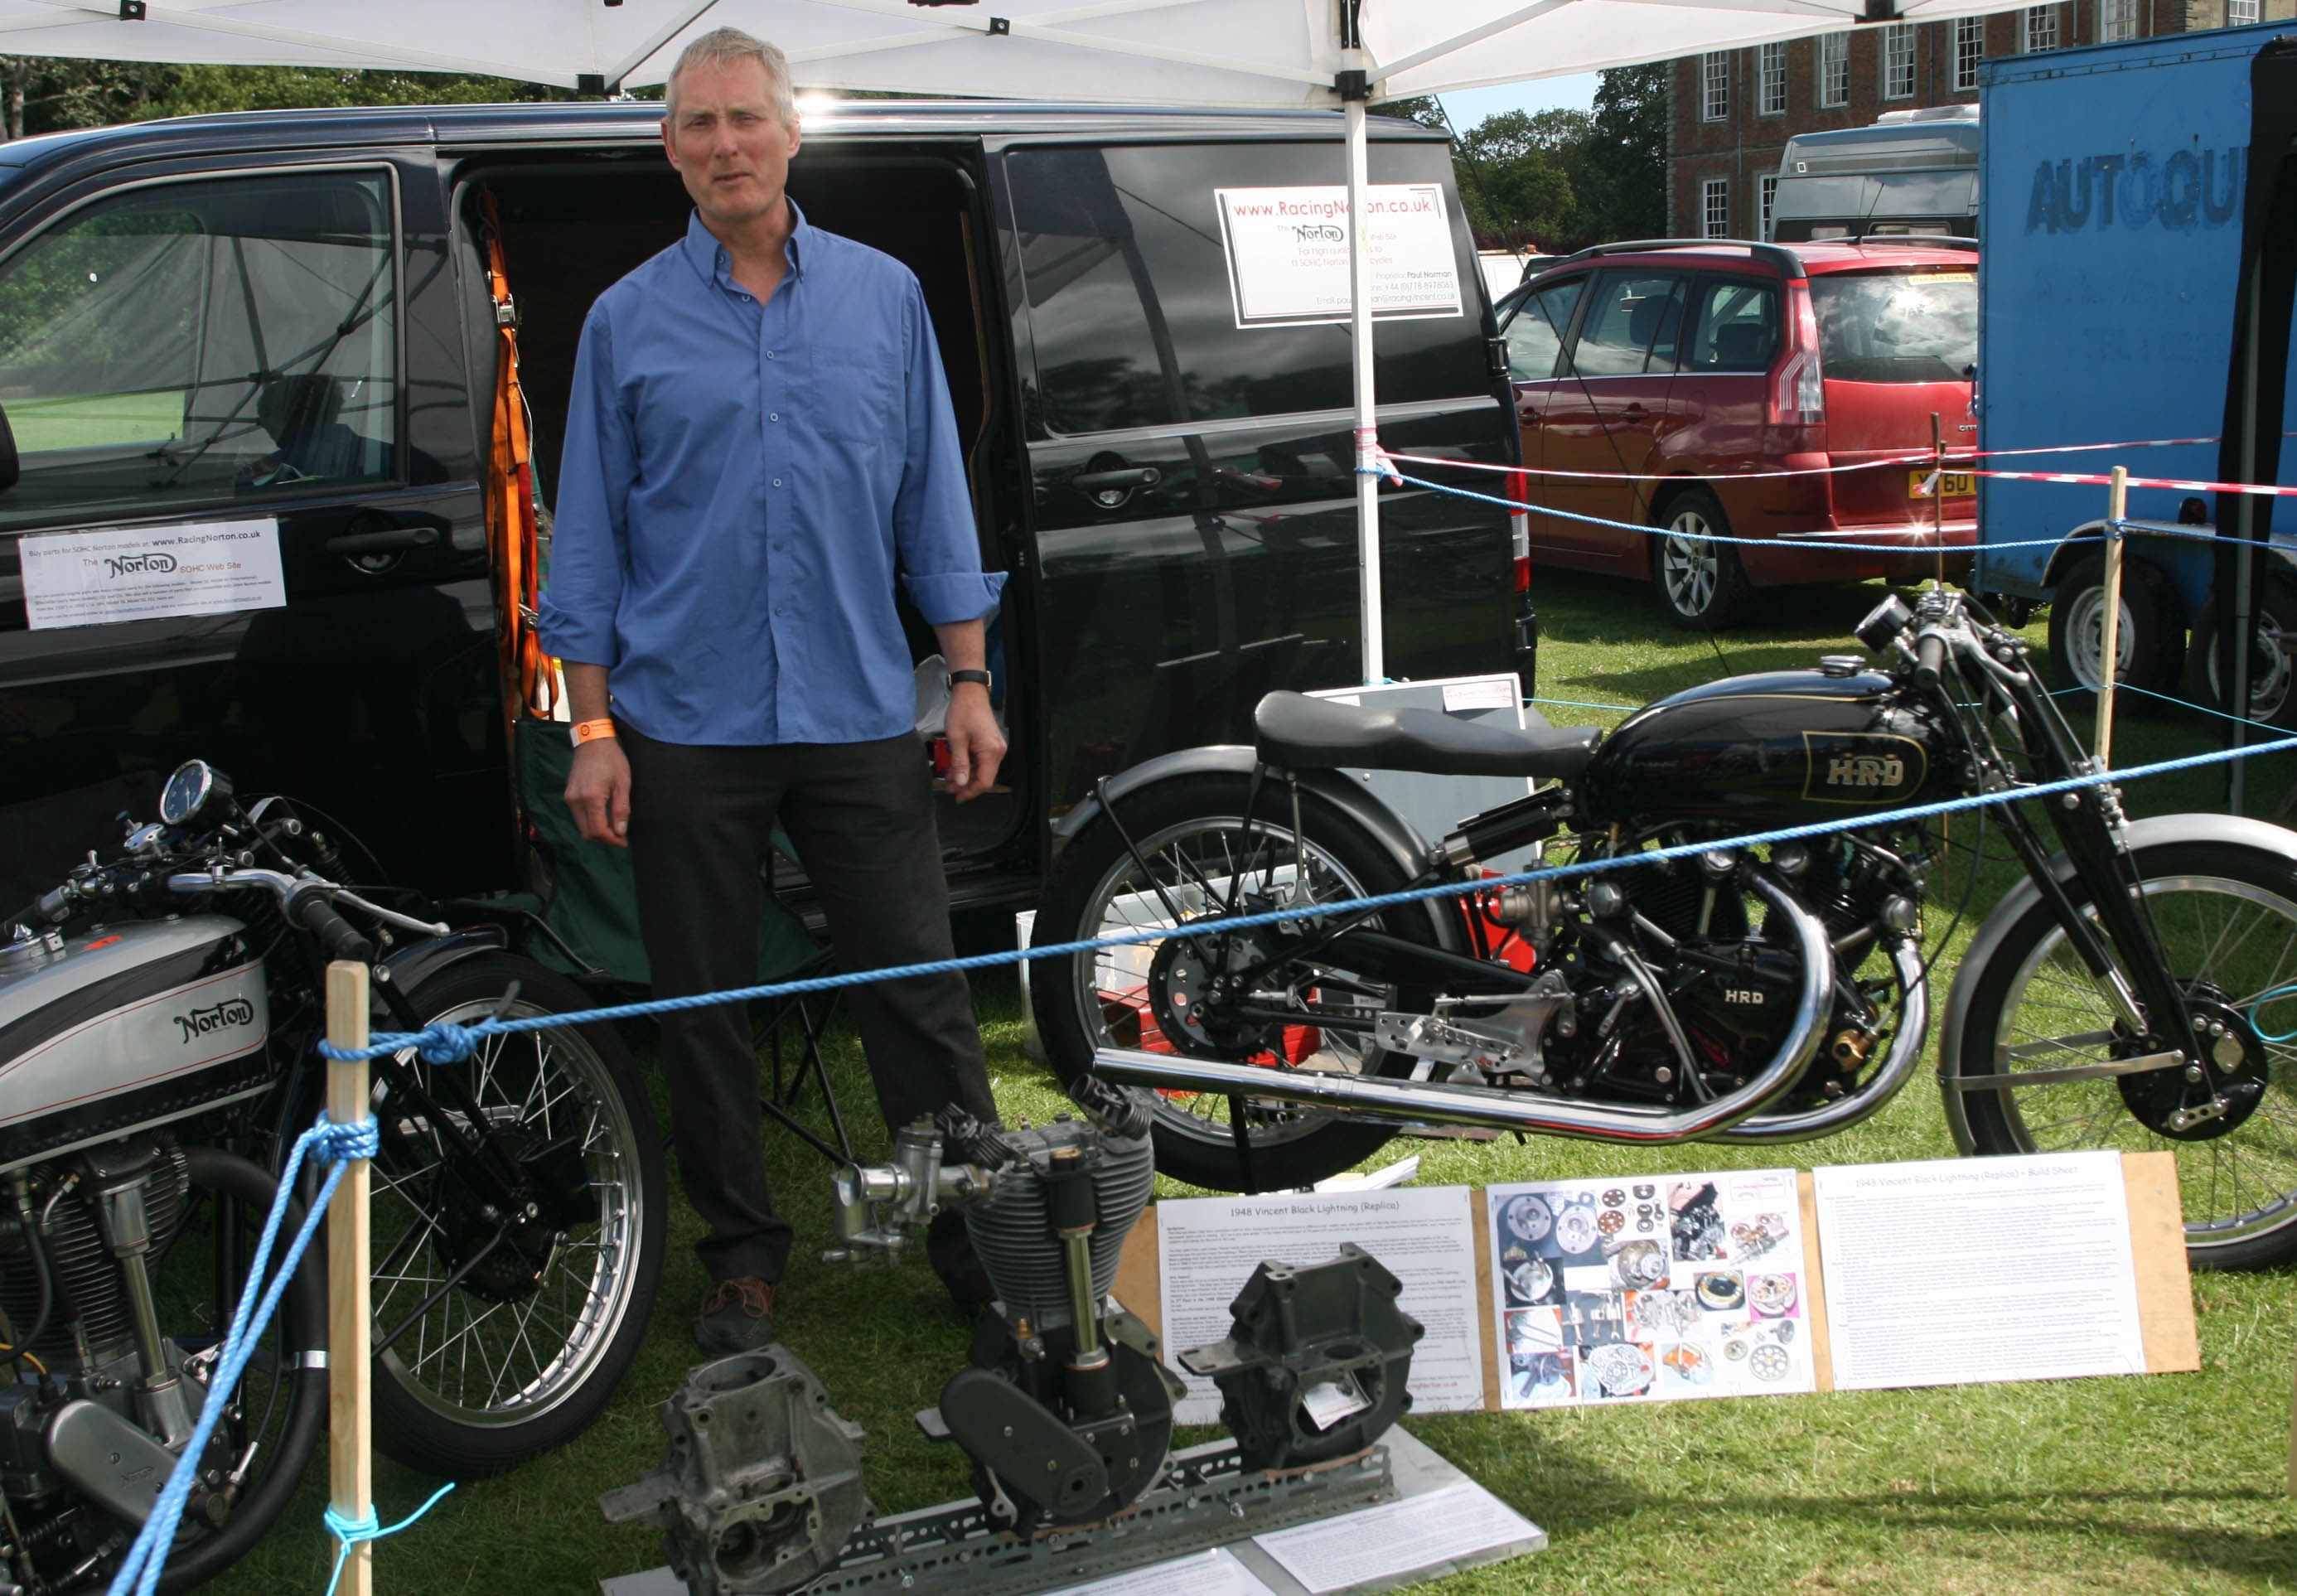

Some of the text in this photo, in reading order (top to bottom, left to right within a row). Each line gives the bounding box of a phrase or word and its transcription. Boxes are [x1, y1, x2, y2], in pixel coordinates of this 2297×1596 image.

[1291, 224, 1344, 243] Norton
[1424, 270, 1452, 278] Norman
[152, 530, 261, 547] www.RacingNorton.co.uk
[83, 559, 99, 567] The
[104, 553, 177, 578] Norton
[180, 564, 205, 573] SOHC
[206, 563, 225, 571] Web
[1725, 989, 1764, 1004] HRD
[173, 999, 254, 1044] Norton
[1231, 1201, 1400, 1217] 1948 Vincent Black Lightning (Replica)
